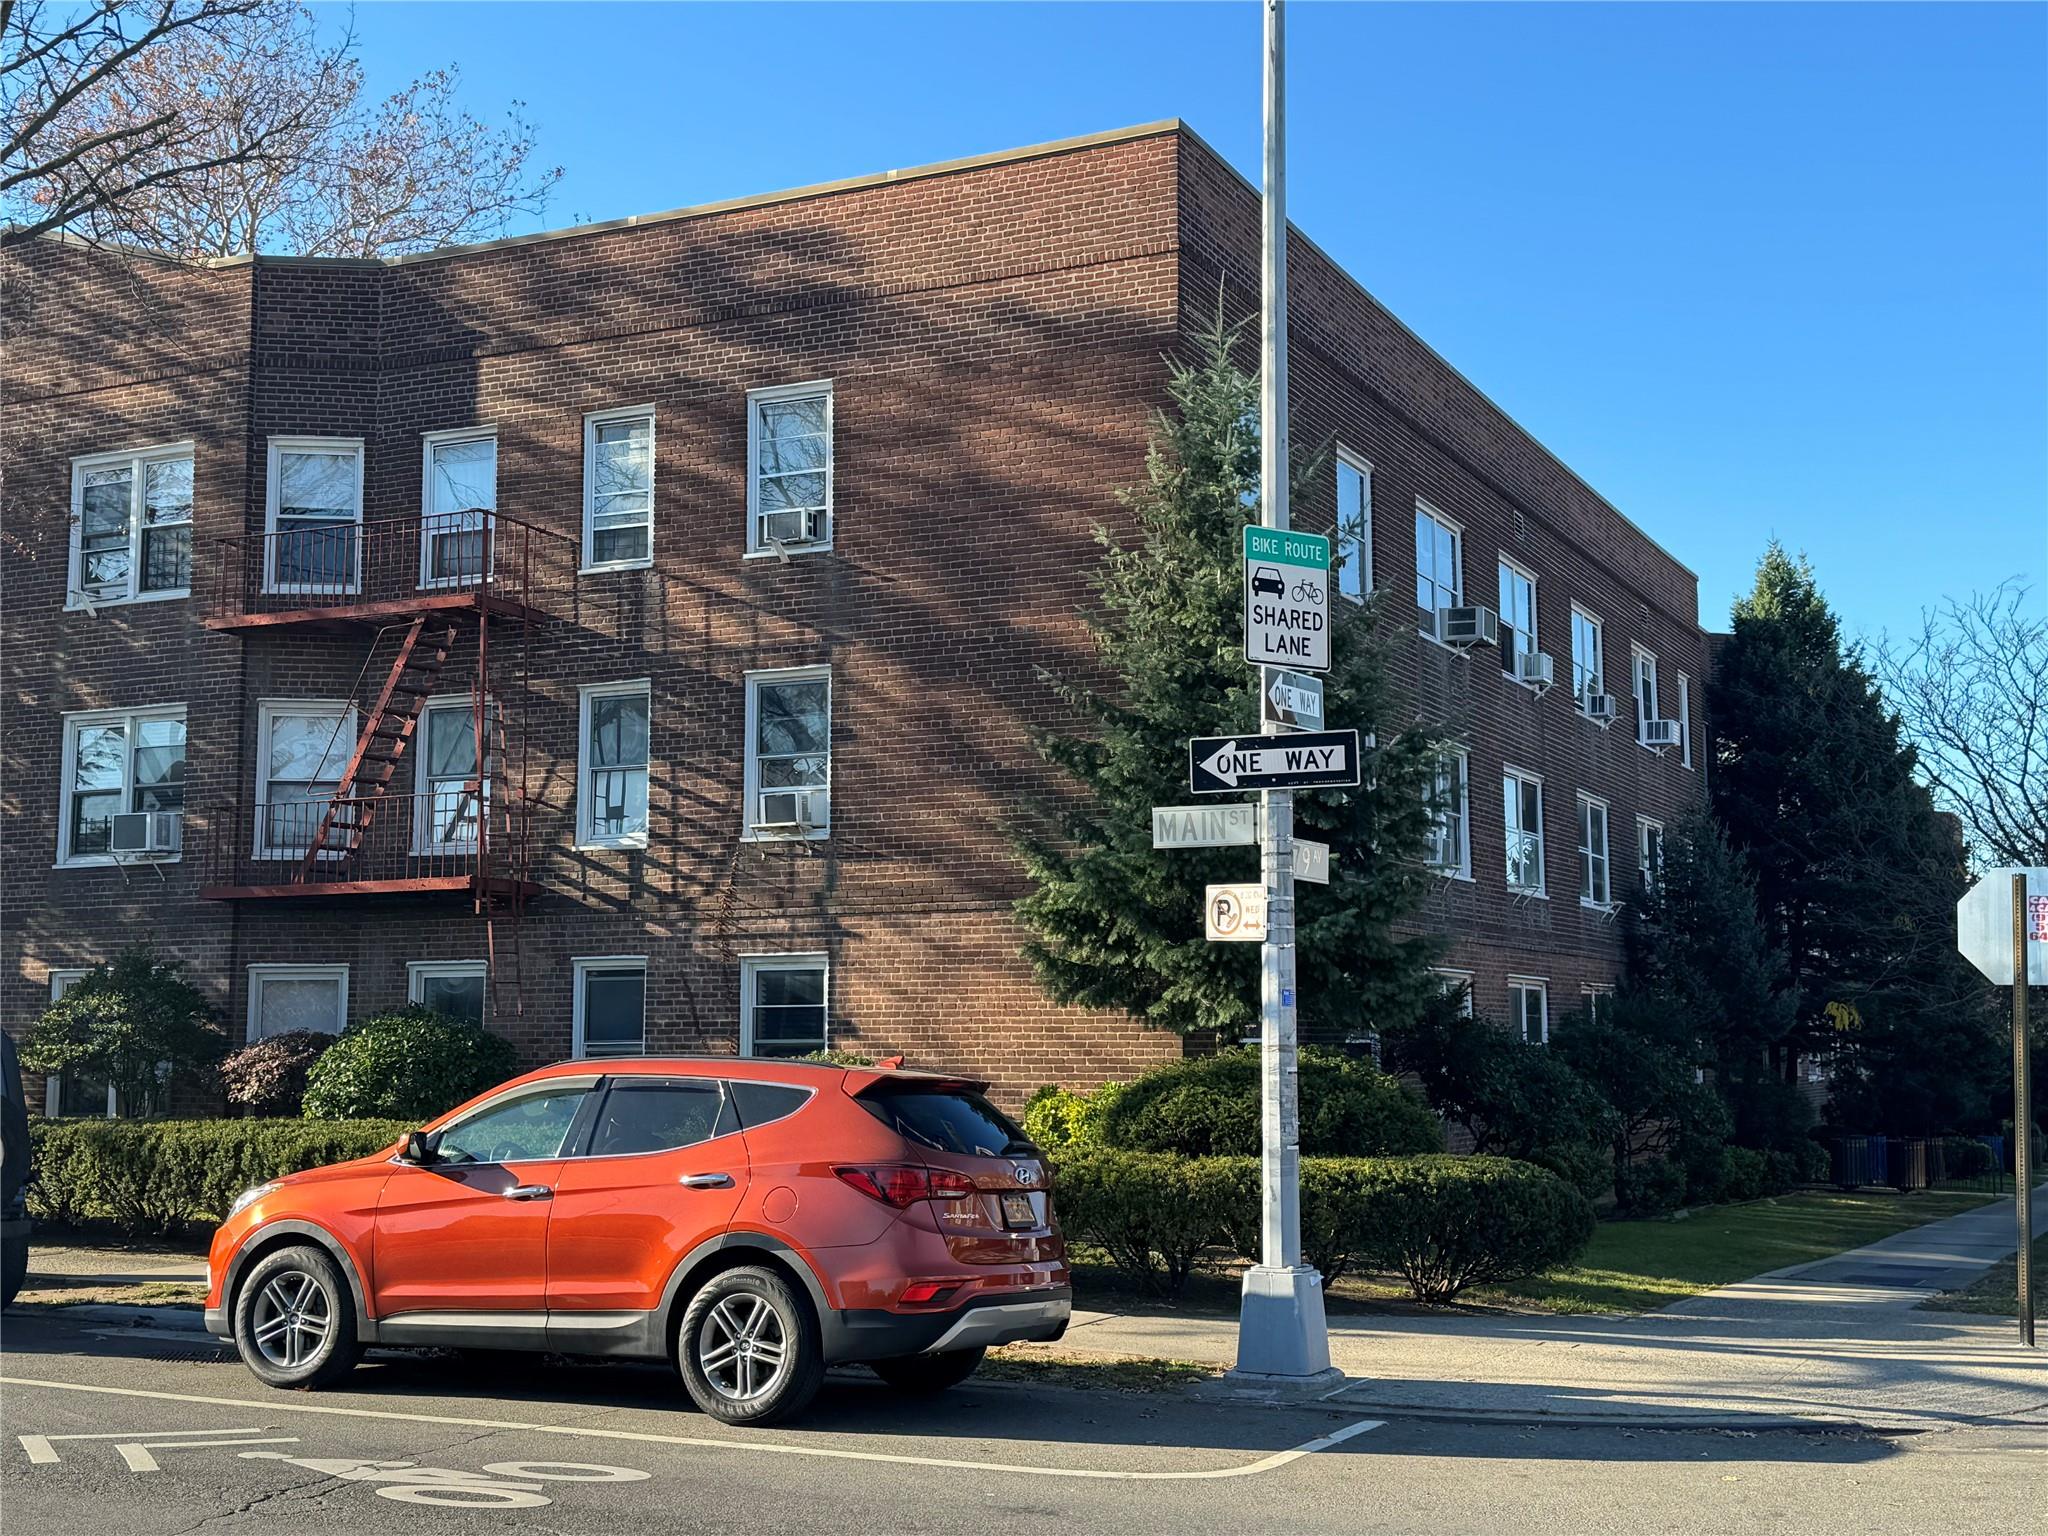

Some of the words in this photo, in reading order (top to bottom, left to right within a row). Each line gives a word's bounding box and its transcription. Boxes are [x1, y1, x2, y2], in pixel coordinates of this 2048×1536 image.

[1252, 536, 1279, 555] BIKE
[1284, 541, 1323, 561] ROUTE
[1253, 604, 1323, 631] SHARED
[1265, 632, 1311, 657] LANE
[1274, 685, 1292, 709] ONE
[1299, 690, 1317, 715] WAY
[1217, 752, 1263, 775] ONE
[1285, 748, 1335, 771] WAY
[1158, 810, 1226, 842] MAIN
[1229, 810, 1249, 825] ST
[1312, 849, 1323, 864] AV
